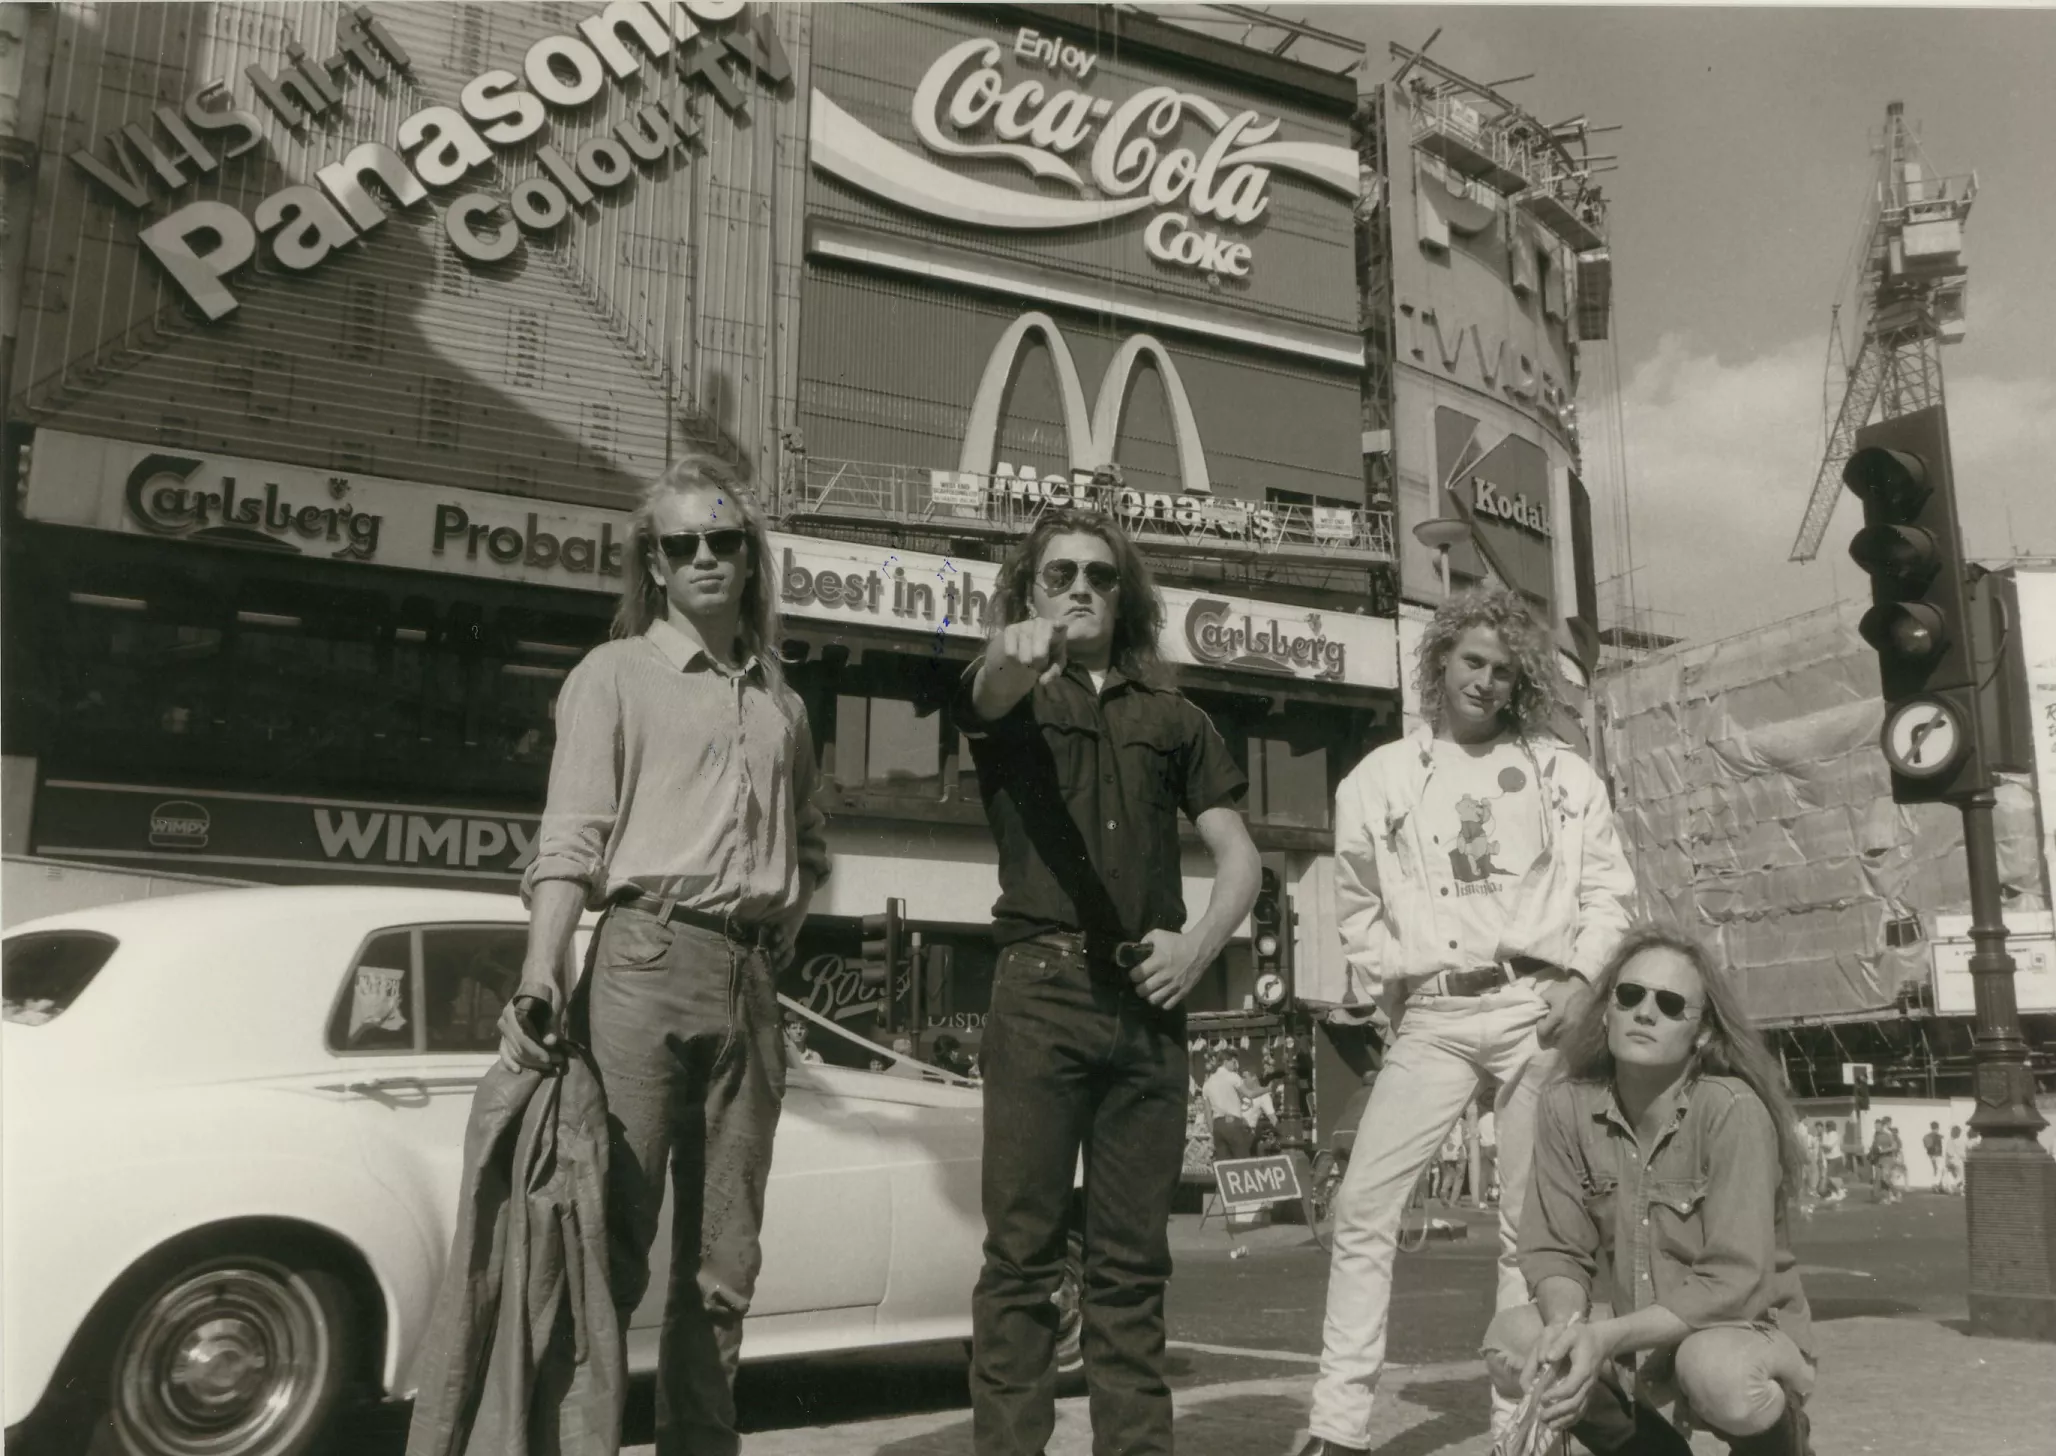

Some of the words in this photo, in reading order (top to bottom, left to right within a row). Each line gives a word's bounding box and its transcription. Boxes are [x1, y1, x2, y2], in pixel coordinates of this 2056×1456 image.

[1014, 27, 1098, 77] Enjoy
[69, 76, 263, 209] VHS
[244, 5, 411, 130] hi-fi
[445, 98, 702, 262] Colour
[680, 12, 793, 110] TV
[911, 37, 1280, 225] Coca-Cola
[138, 2, 746, 322] Panasoni
[1144, 212, 1253, 276] Coke
[125, 453, 384, 560] Carlsberg
[780, 547, 887, 614] best
[892, 566, 935, 619] in
[1184, 598, 1346, 681] Carlsberg
[150, 819, 211, 834] WIMPY
[313, 808, 542, 869] WIMPY
[1225, 1165, 1286, 1195] RAMP
